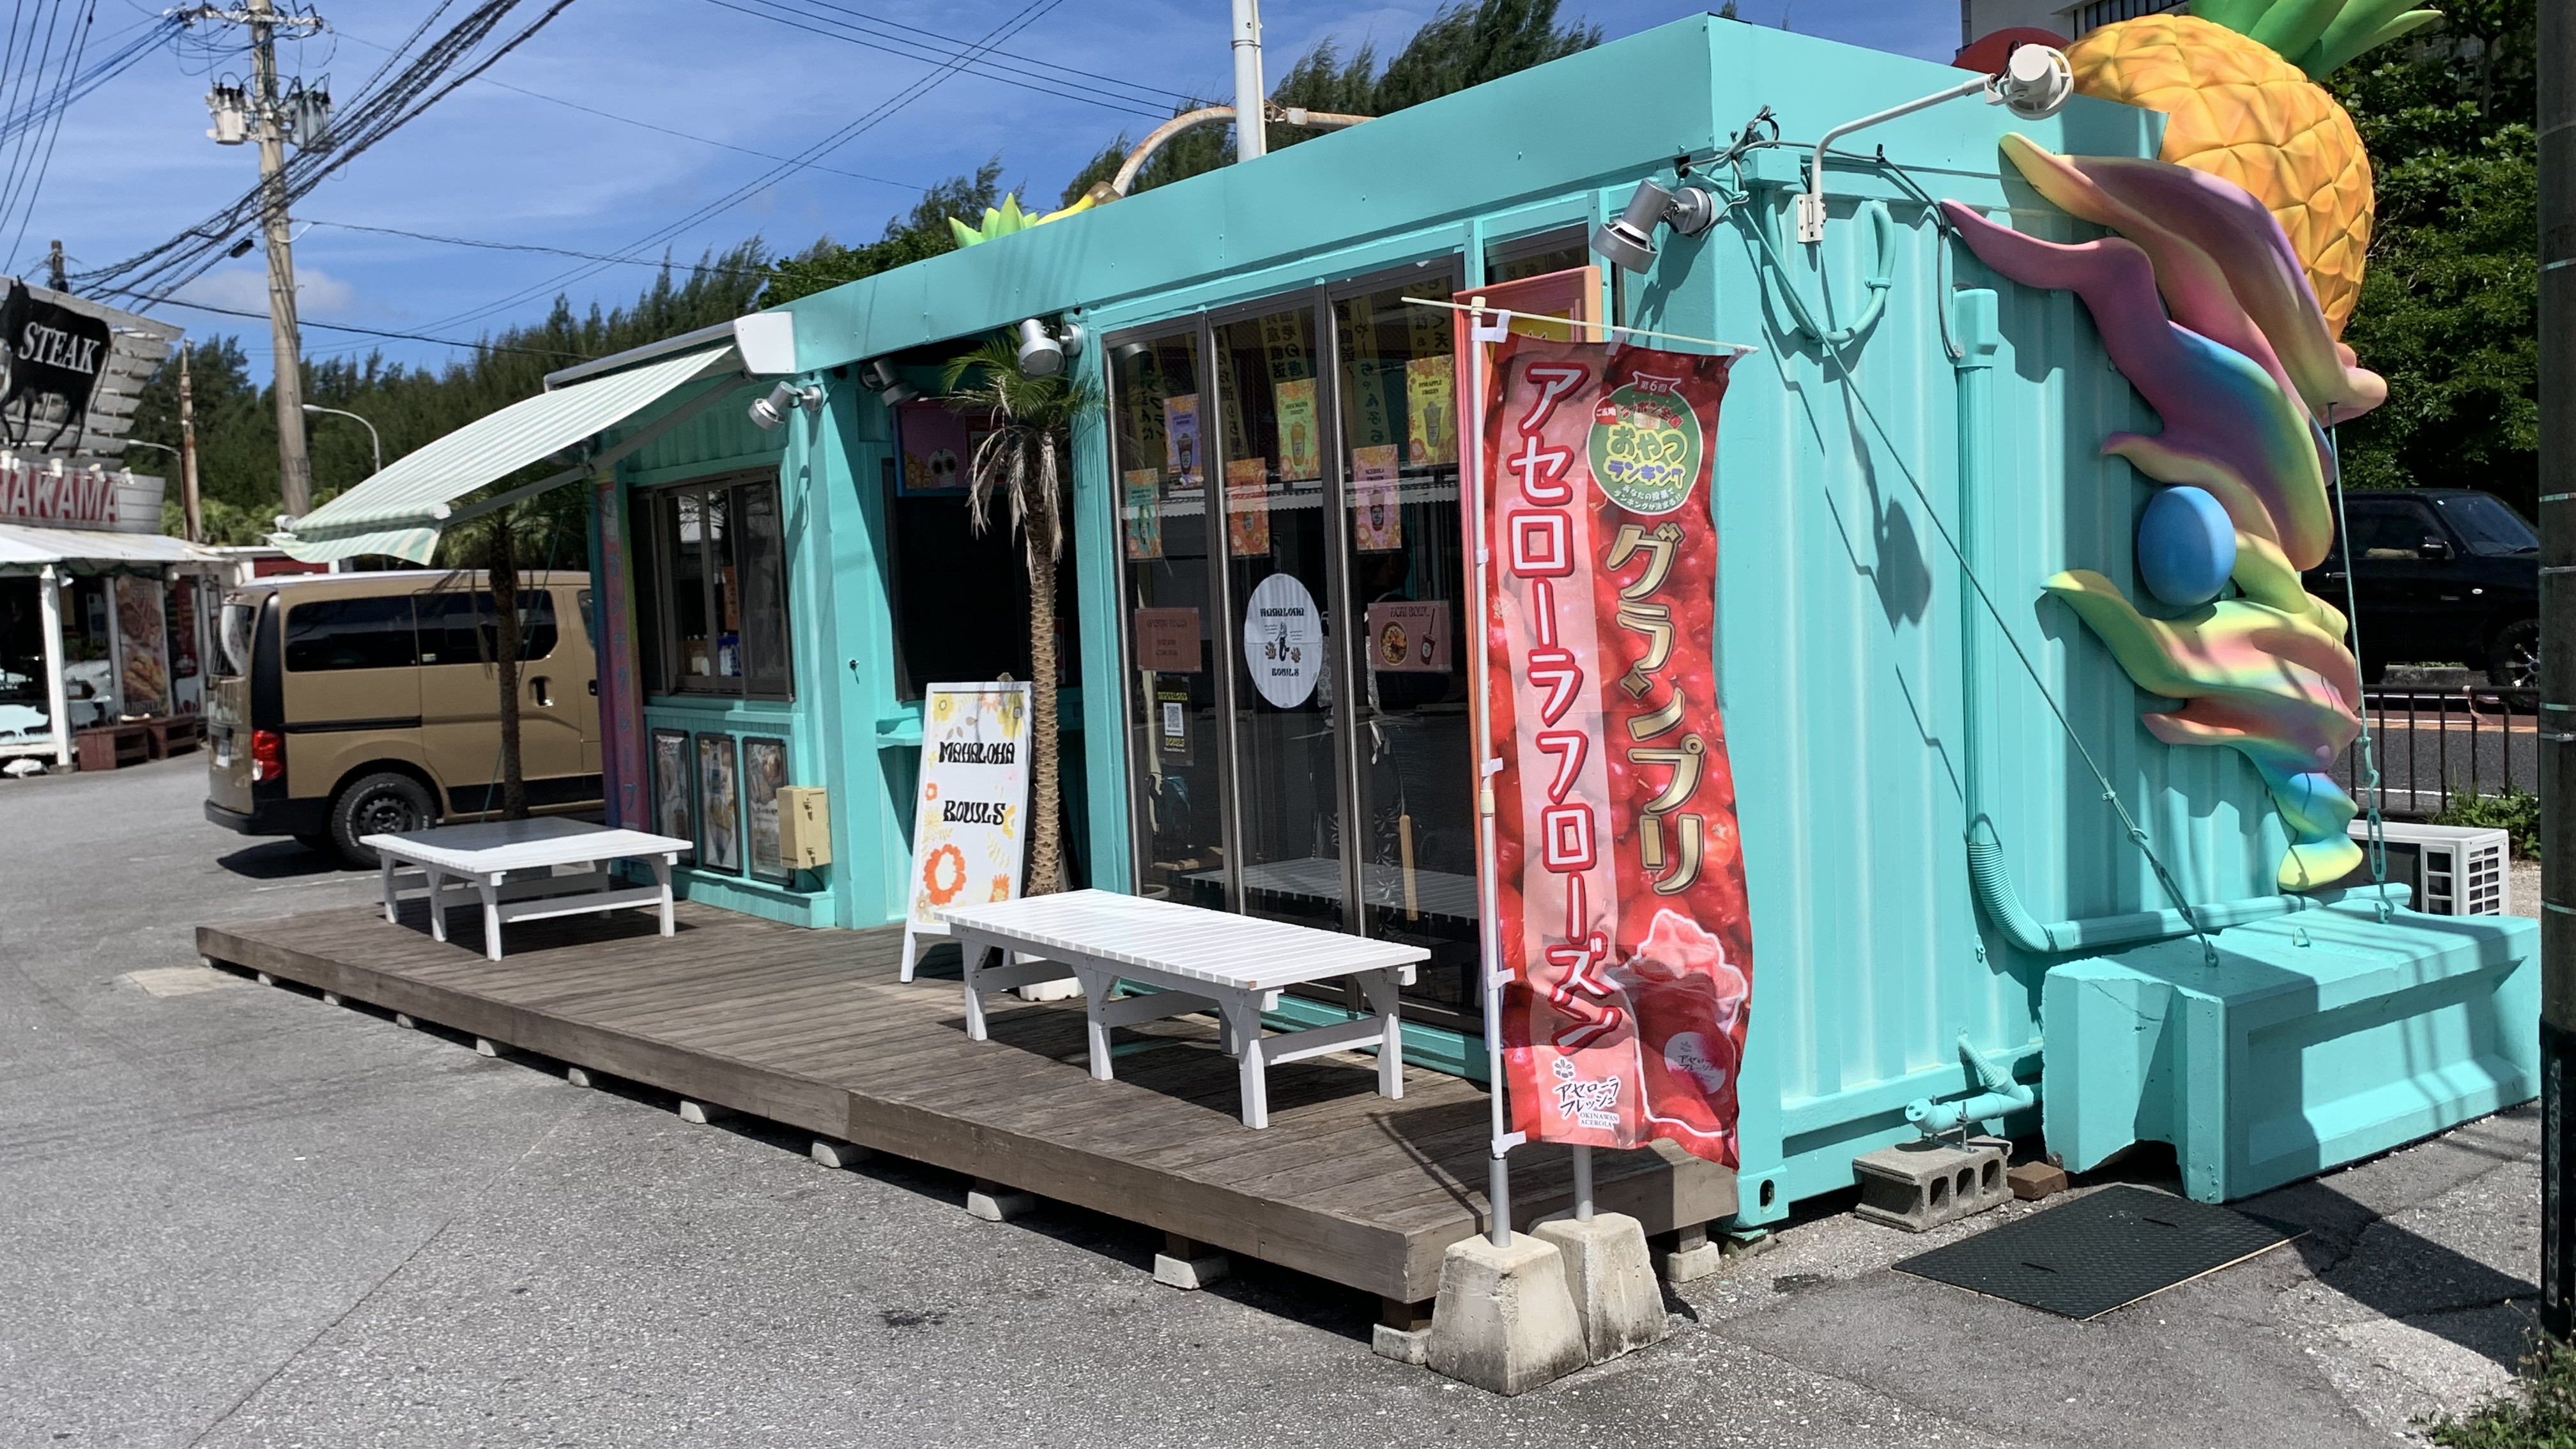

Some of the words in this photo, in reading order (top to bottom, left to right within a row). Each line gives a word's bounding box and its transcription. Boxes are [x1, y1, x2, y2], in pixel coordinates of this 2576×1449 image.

[18, 321, 100, 374] STEAK
[1640, 381, 1667, 392] 第6回
[1607, 422, 1687, 463] おやつ
[1605, 457, 1685, 487] ランキング
[1271, 668, 1300, 677] BOWLS
[1507, 362, 1622, 1055] アセローラフローズン
[1607, 523, 1706, 895] グランプリ
[939, 741, 1015, 765] MAHALOHA
[943, 800, 1006, 825] BOWLS
[1554, 1078, 1619, 1102] アセローラ
[1560, 1094, 1614, 1117] フレッシュ
[1580, 1112, 1618, 1121] OKINAWAN
[1581, 1119, 1612, 1128] ACEROLA
